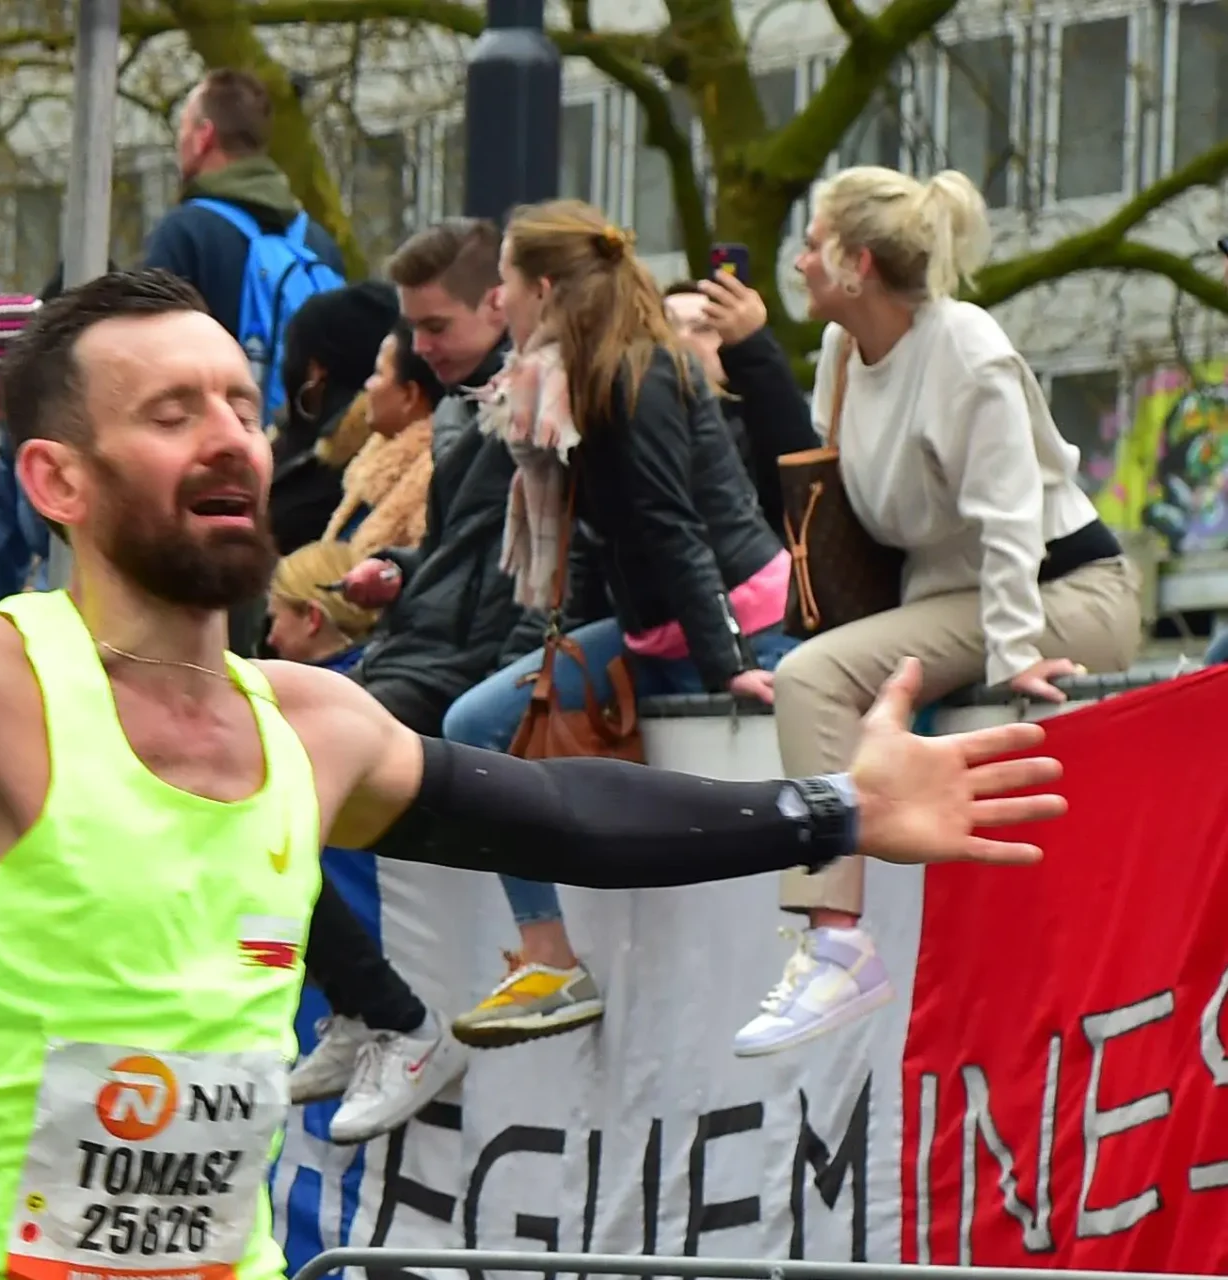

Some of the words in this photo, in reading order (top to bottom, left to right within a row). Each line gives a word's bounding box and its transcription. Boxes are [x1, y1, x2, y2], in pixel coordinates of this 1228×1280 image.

[187, 1080, 256, 1123] NN
[78, 1139, 243, 1197] TOMASZ
[77, 1203, 212, 1256] 25826
